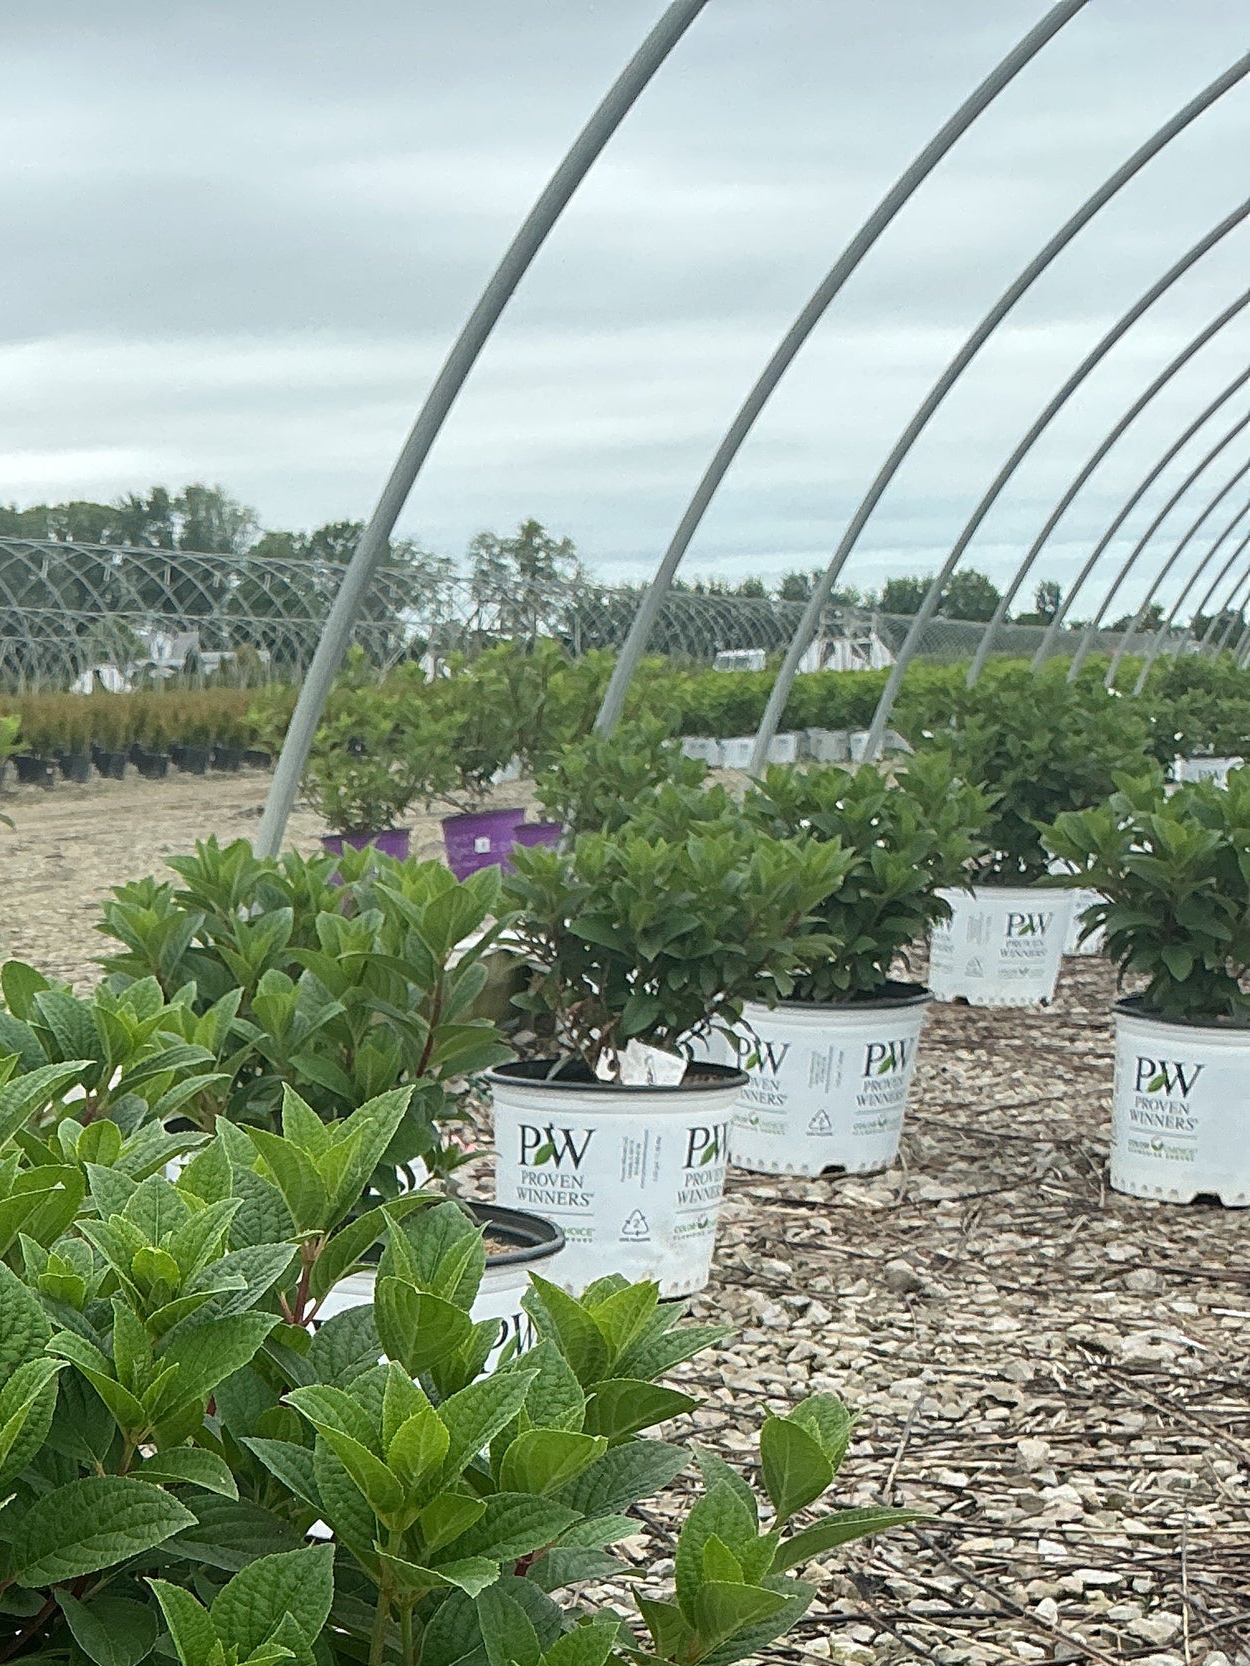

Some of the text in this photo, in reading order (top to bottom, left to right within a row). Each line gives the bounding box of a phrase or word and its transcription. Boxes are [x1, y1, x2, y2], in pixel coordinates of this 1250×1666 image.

[1004, 911, 1054, 937] PW
[861, 1038, 916, 1078] PW
[1134, 1055, 1207, 1098] PW
[1135, 1096, 1190, 1115] PROVEN
[518, 1122, 596, 1170] PW
[521, 1170, 584, 1189] PROVEN
